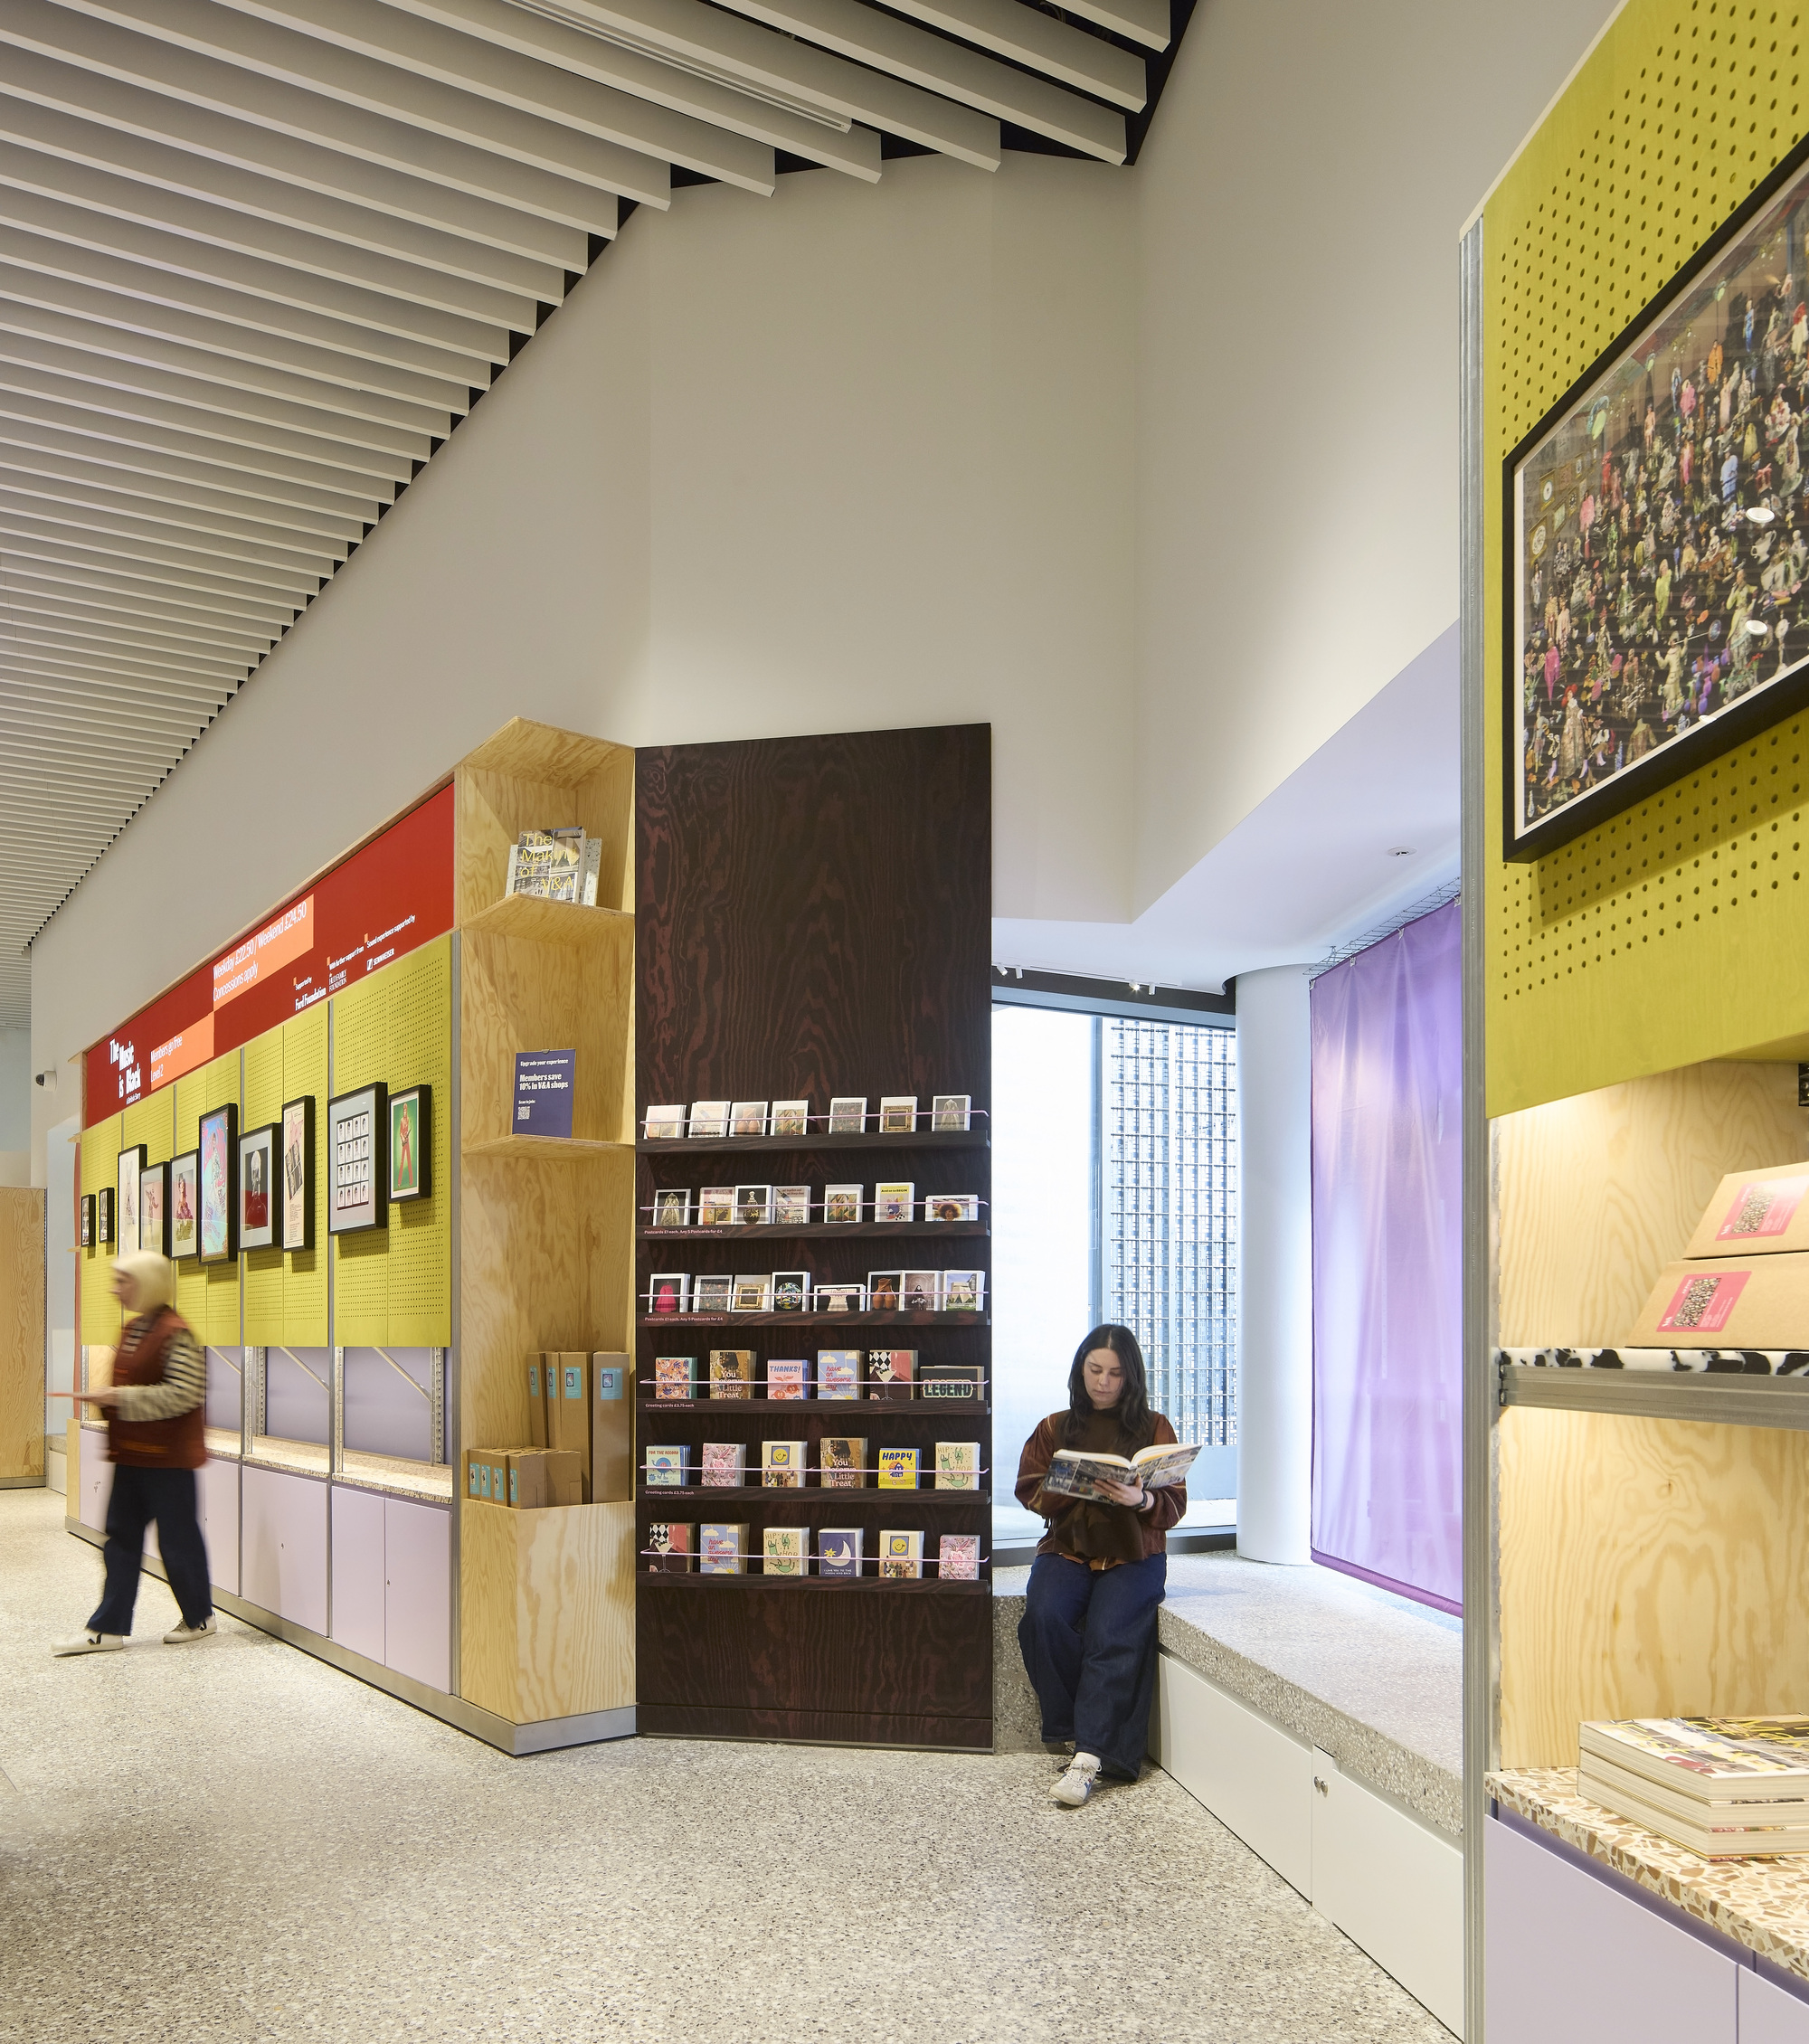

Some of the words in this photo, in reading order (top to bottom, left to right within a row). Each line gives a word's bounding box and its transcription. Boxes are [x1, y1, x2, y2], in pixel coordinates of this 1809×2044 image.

[523, 833, 553, 847] The
[521, 848, 577, 862] Making
[520, 862, 538, 878] of
[541, 875, 573, 891] V&A
[213, 956, 235, 979] Weekday
[235, 942, 254, 966] £22.50
[258, 920, 284, 949] Weekend
[284, 901, 307, 931] £24.50
[213, 973, 244, 1002] Concessions
[243, 960, 258, 984] apply
[304, 986, 327, 1007] Foundation
[109, 1038, 119, 1065] The
[118, 1040, 135, 1071] Music
[150, 1044, 169, 1065] Members
[174, 1035, 183, 1051] free
[118, 1074, 125, 1099] is
[126, 1062, 141, 1094] Black
[150, 1065, 160, 1083] Level
[160, 1063, 164, 1078] 2
[538, 1082, 550, 1090] V&A
[551, 1081, 569, 1090] shops
[721, 1370, 736, 1378] You
[723, 1384, 743, 1392] Little
[923, 1380, 973, 1397] LEGEND
[882, 1452, 913, 1461] HAPPY
[707, 1556, 720, 1564] day
